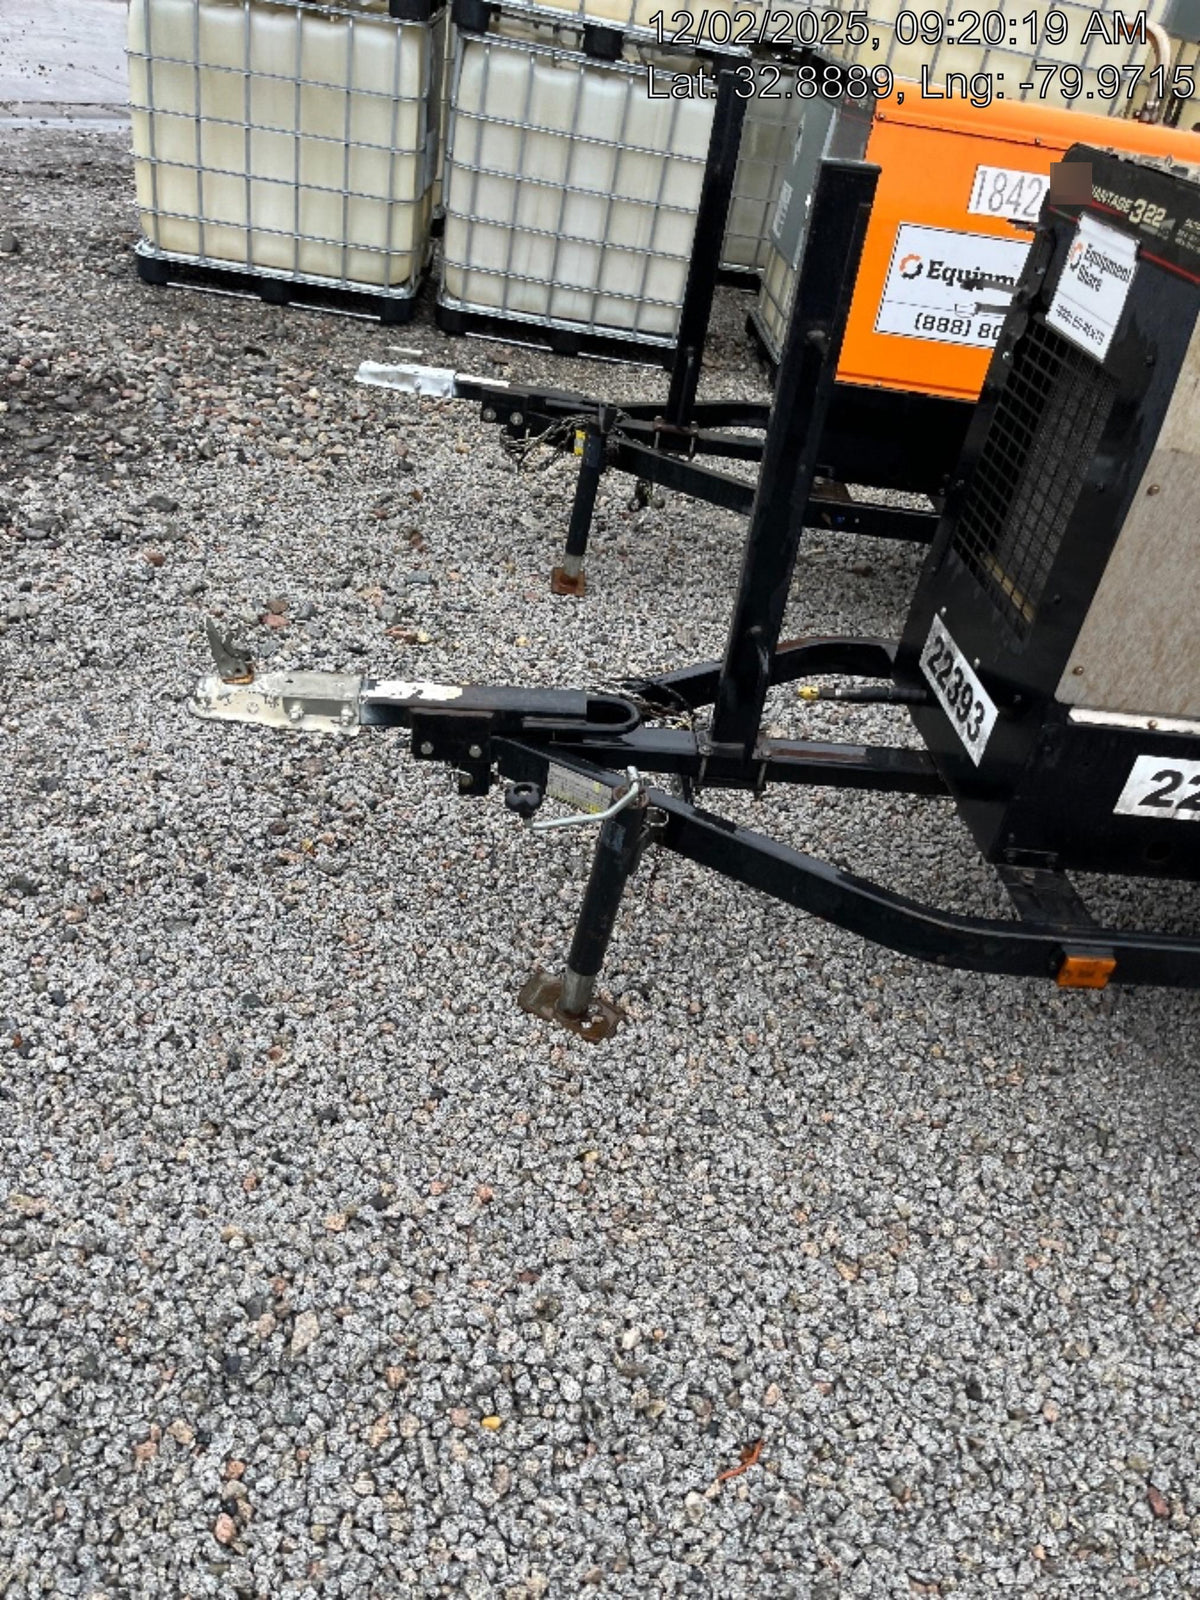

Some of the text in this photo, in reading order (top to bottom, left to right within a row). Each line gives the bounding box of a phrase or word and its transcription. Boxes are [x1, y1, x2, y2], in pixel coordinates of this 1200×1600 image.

[1128, 198, 1167, 227] 322
[914, 312, 972, 337] (888)
[927, 635, 985, 743] 22393
